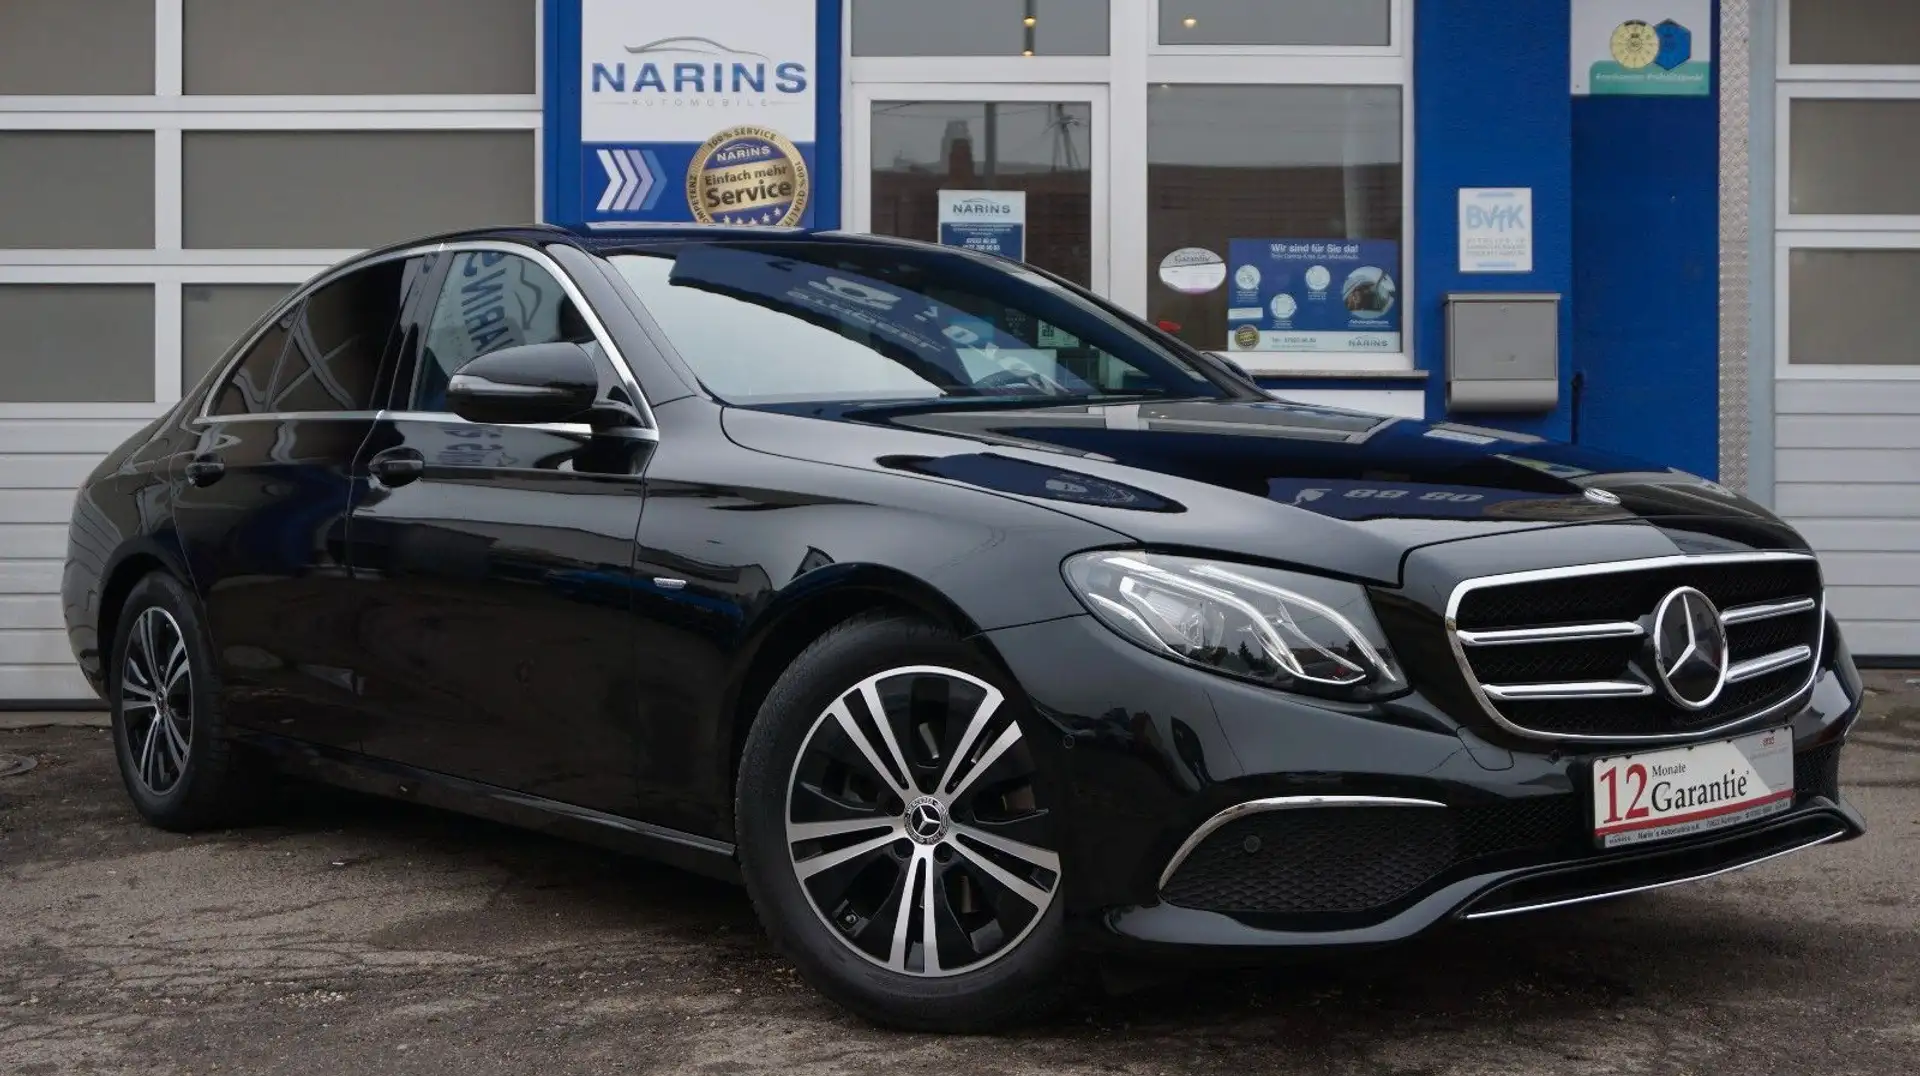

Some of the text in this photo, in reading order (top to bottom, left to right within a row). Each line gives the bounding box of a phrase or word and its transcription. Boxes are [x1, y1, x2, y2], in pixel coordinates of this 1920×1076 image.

[592, 62, 808, 93] NARINS
[733, 127, 777, 141] SERVICE
[717, 147, 771, 162] NARINS
[705, 165, 788, 185] Einfach mehr
[706, 179, 793, 208] Service
[953, 204, 1011, 214] NARINS
[1271, 243, 1287, 252] Wir
[1289, 243, 1309, 252] sind
[1311, 243, 1325, 253] für
[1327, 243, 1342, 253] Sie
[1348, 339, 1389, 347] NARINS
[1652, 763, 1687, 777] Monate
[1600, 763, 1649, 824] 12
[1651, 769, 1748, 812] Garantie
